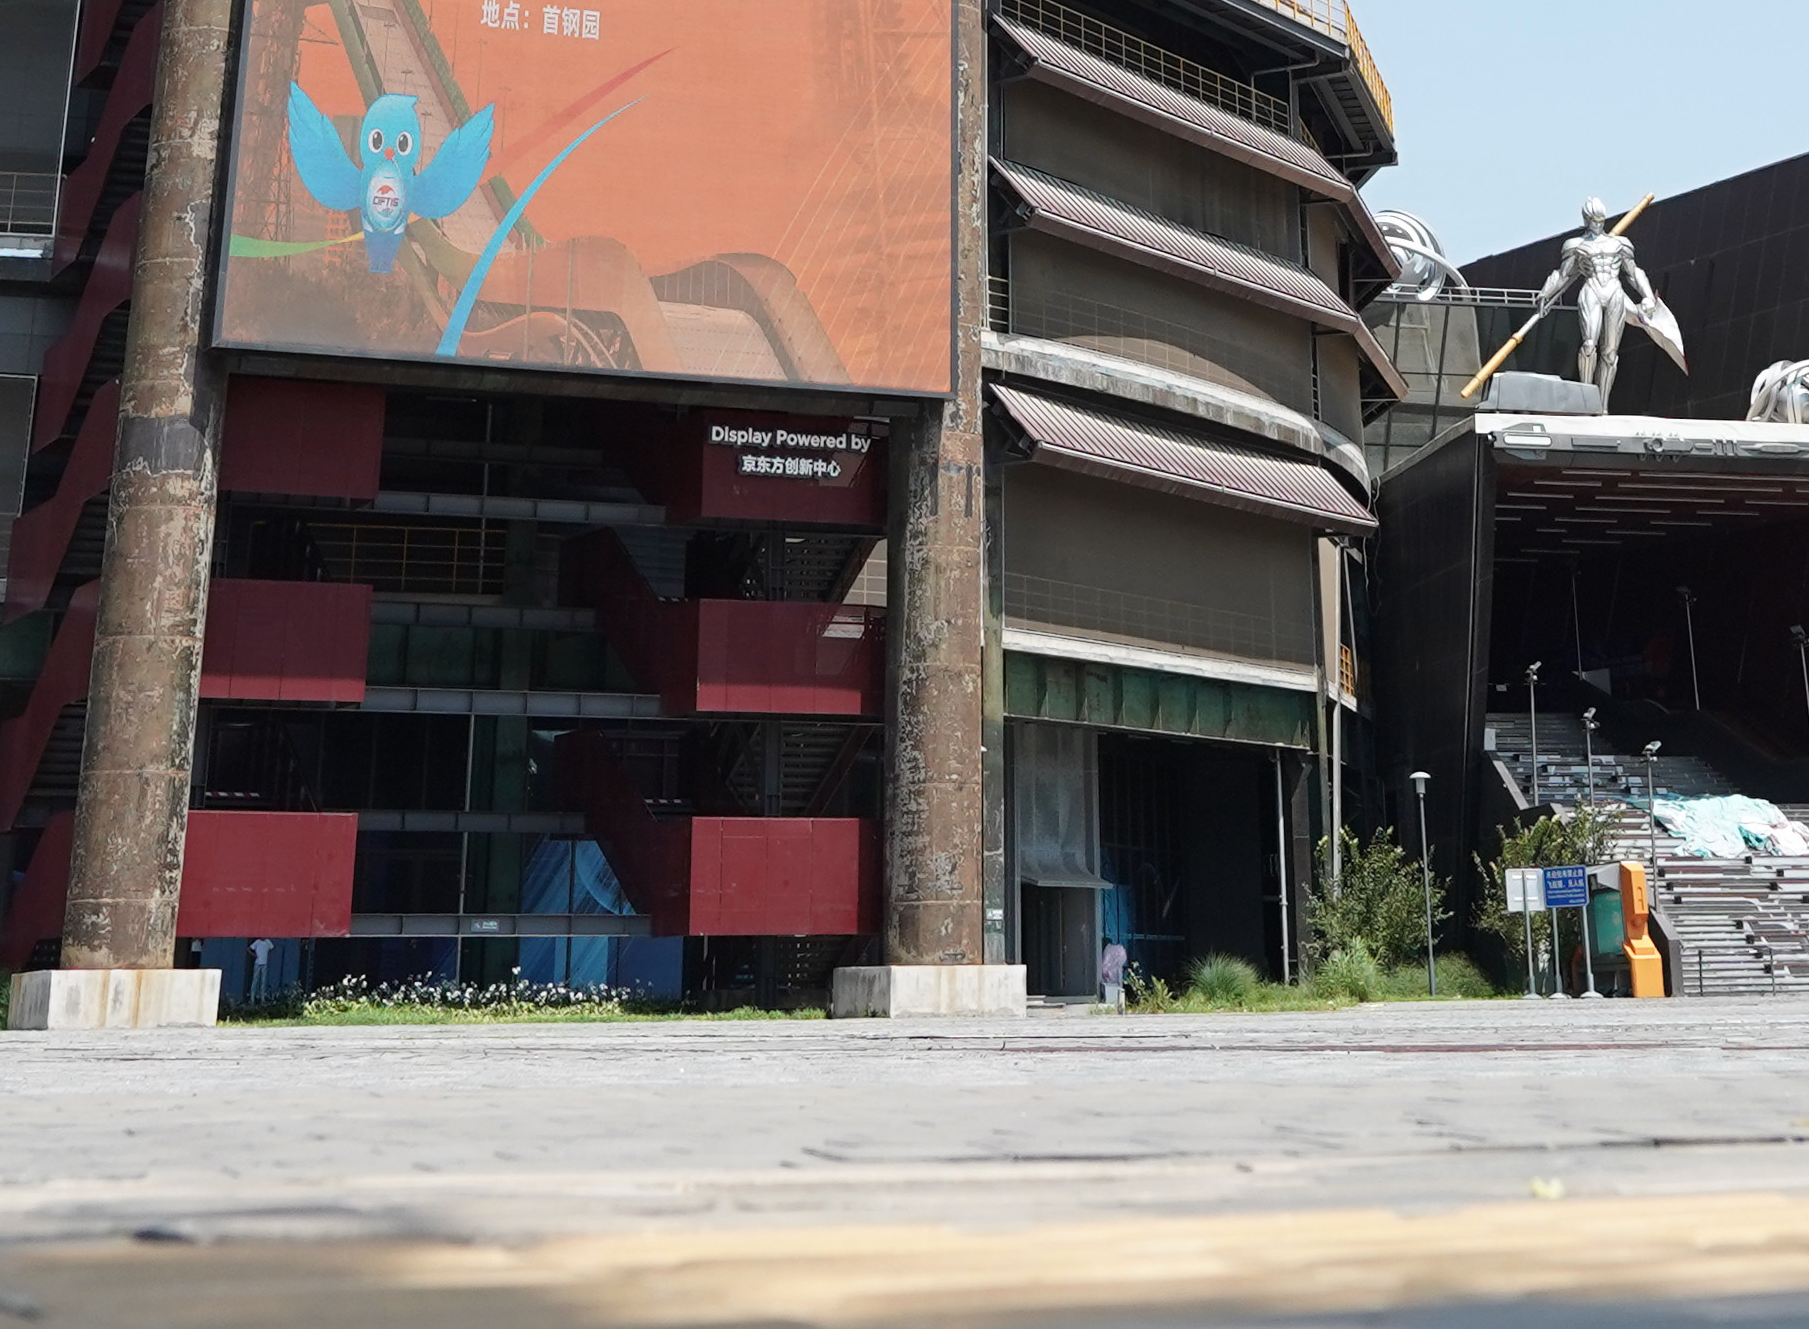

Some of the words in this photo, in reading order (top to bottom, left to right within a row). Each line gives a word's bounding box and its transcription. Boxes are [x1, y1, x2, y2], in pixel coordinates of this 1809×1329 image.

[711, 425, 772, 447] Display
[776, 429, 846, 450] Powered
[850, 433, 872, 453] by
[741, 454, 841, 477] 京东方创新中心
